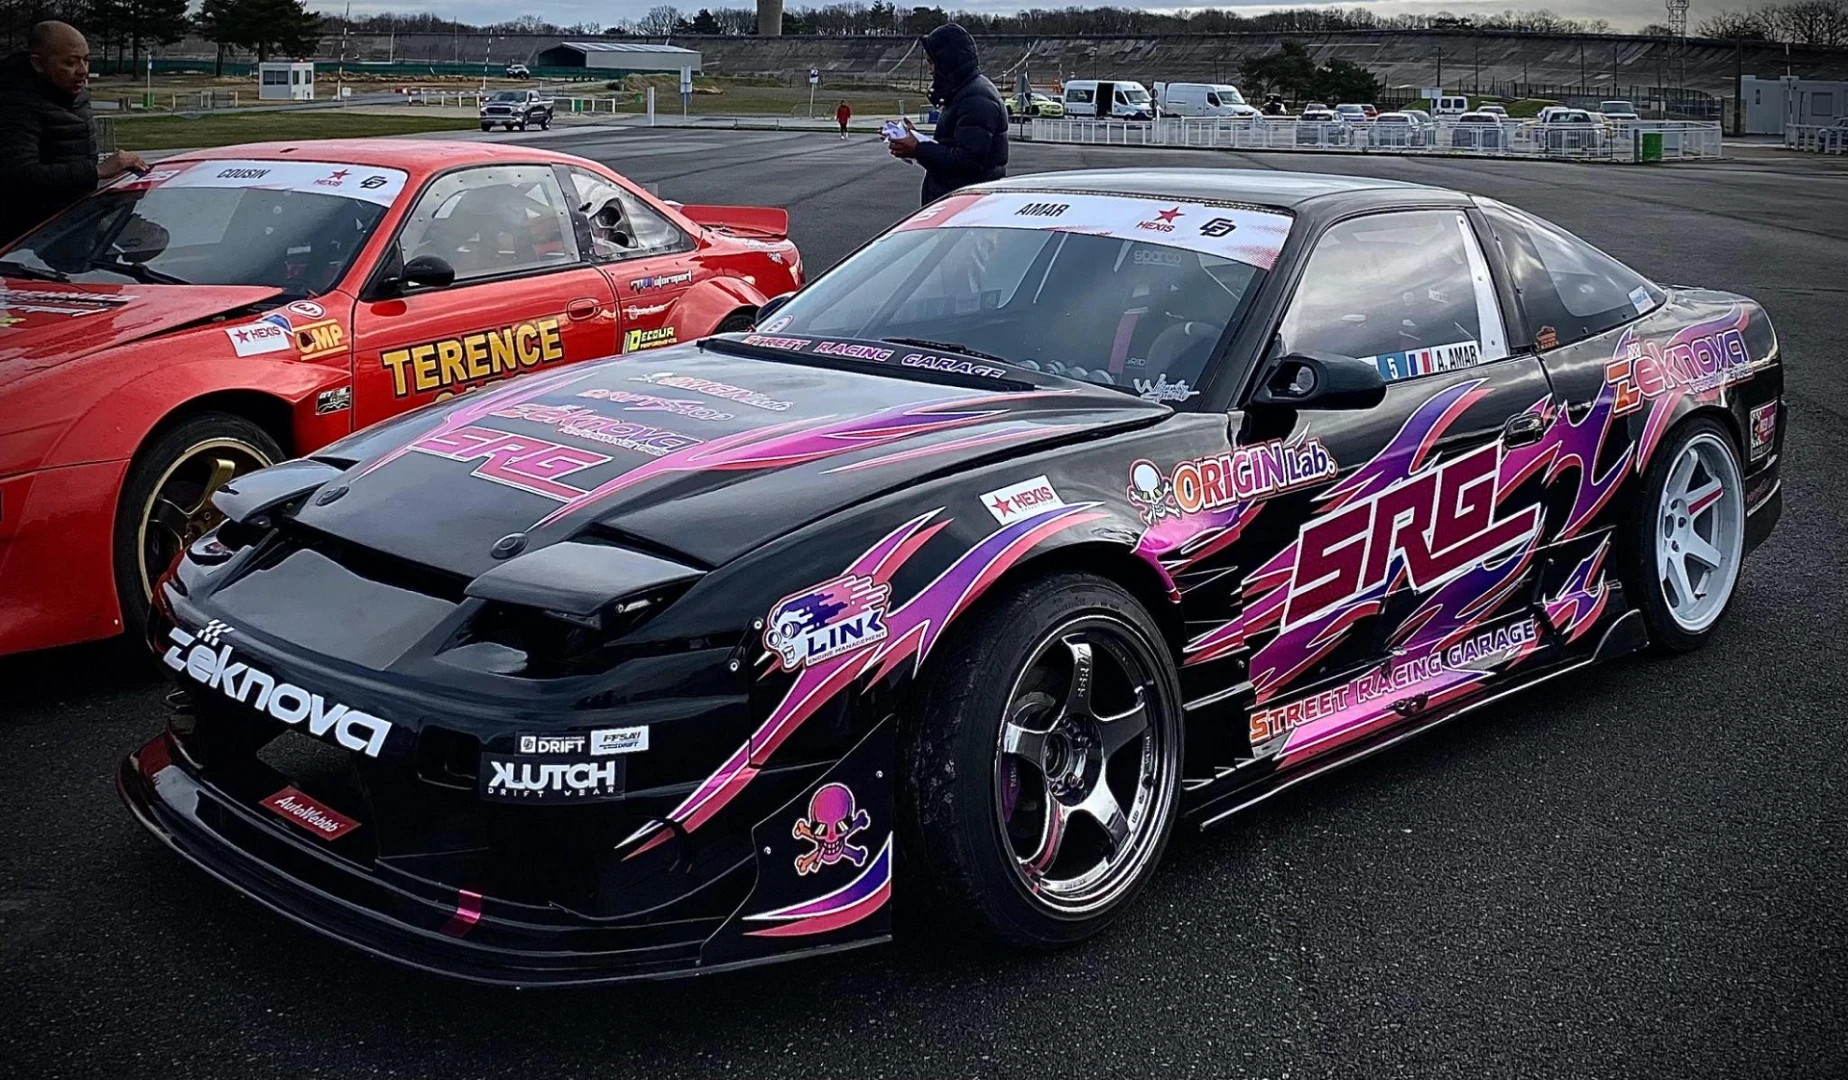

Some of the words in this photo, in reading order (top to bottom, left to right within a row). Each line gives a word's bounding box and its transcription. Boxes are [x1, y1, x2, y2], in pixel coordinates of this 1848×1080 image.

[216, 167, 271, 180] COUSIN
[312, 178, 343, 187] HEXIS
[1014, 202, 1070, 217] AMAR
[1135, 220, 1176, 233] HEXIS
[1133, 249, 1182, 264] sparco
[250, 326, 281, 341] HEXIS
[381, 317, 564, 396] TERENCE
[741, 334, 812, 351] STREET
[815, 341, 894, 362] RACING
[901, 353, 1006, 380] GARAGE
[1386, 357, 1399, 380] 5
[1436, 349, 1449, 371] A.
[1449, 344, 1479, 370] AMAR
[409, 425, 614, 503] SRG
[1172, 439, 1289, 516] ORIGIN
[1286, 439, 1338, 483] Lab.
[1010, 486, 1054, 509] HEXIS
[1280, 440, 1542, 634] SRG
[807, 611, 884, 658] LINK
[807, 650, 834, 665] ENGINE
[834, 631, 886, 656] MANAGEMENT
[1249, 680, 1350, 744] STREET
[1356, 651, 1444, 702] RACING
[1446, 619, 1537, 667] GARAGE
[538, 740, 585, 753] DRIFT
[489, 760, 616, 790] KLUTCH
[487, 786, 544, 798] DRIFT
[564, 785, 615, 797] WEAR
